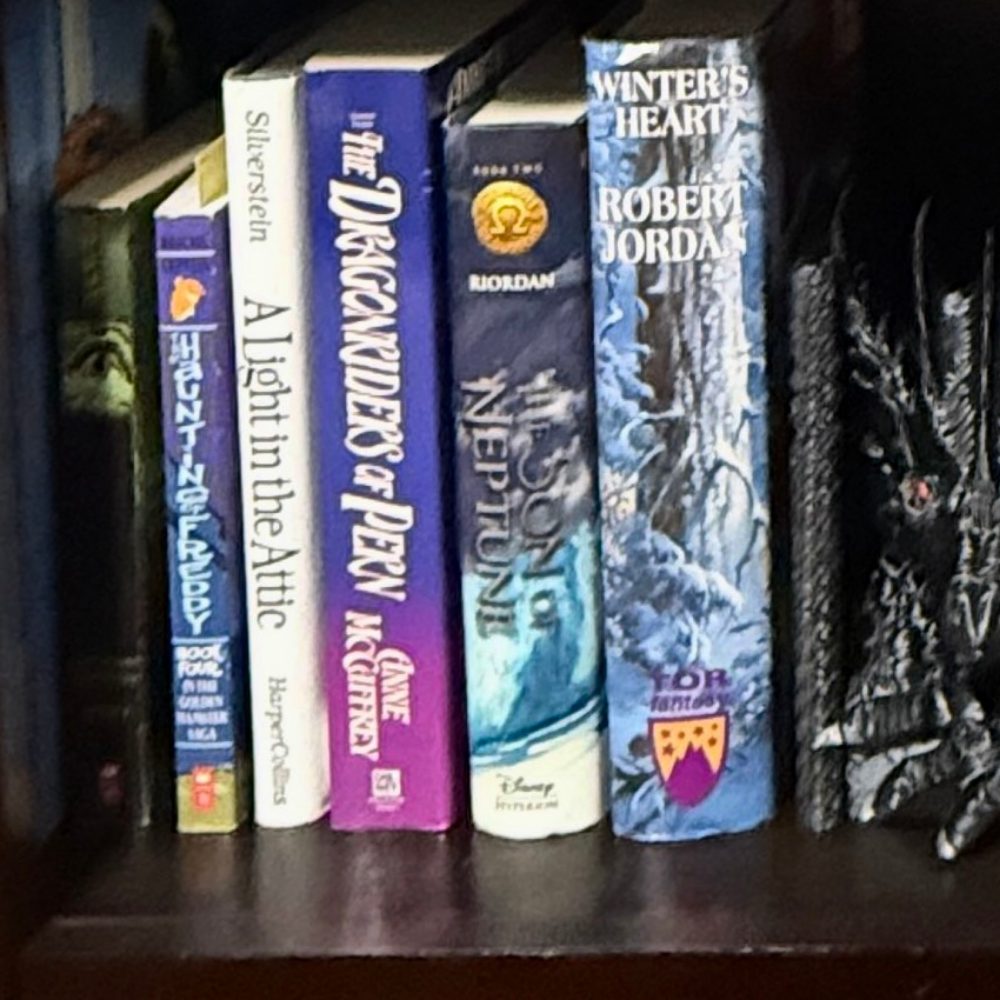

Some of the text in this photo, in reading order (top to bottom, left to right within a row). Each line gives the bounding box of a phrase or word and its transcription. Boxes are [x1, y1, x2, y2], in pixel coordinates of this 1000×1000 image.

[592, 64, 749, 102] WINTER'S
[614, 101, 726, 139] HEART
[245, 110, 272, 243] Silverstein
[599, 182, 749, 222] ROBERT
[328, 176, 404, 463] DRAGONRIDERS
[468, 272, 555, 293] RIORDAN
[238, 296, 301, 630] A Light in the Attic
[461, 370, 520, 640] NEPTUNE
[177, 512, 214, 636] FREDDY
[340, 493, 414, 602] PERN
